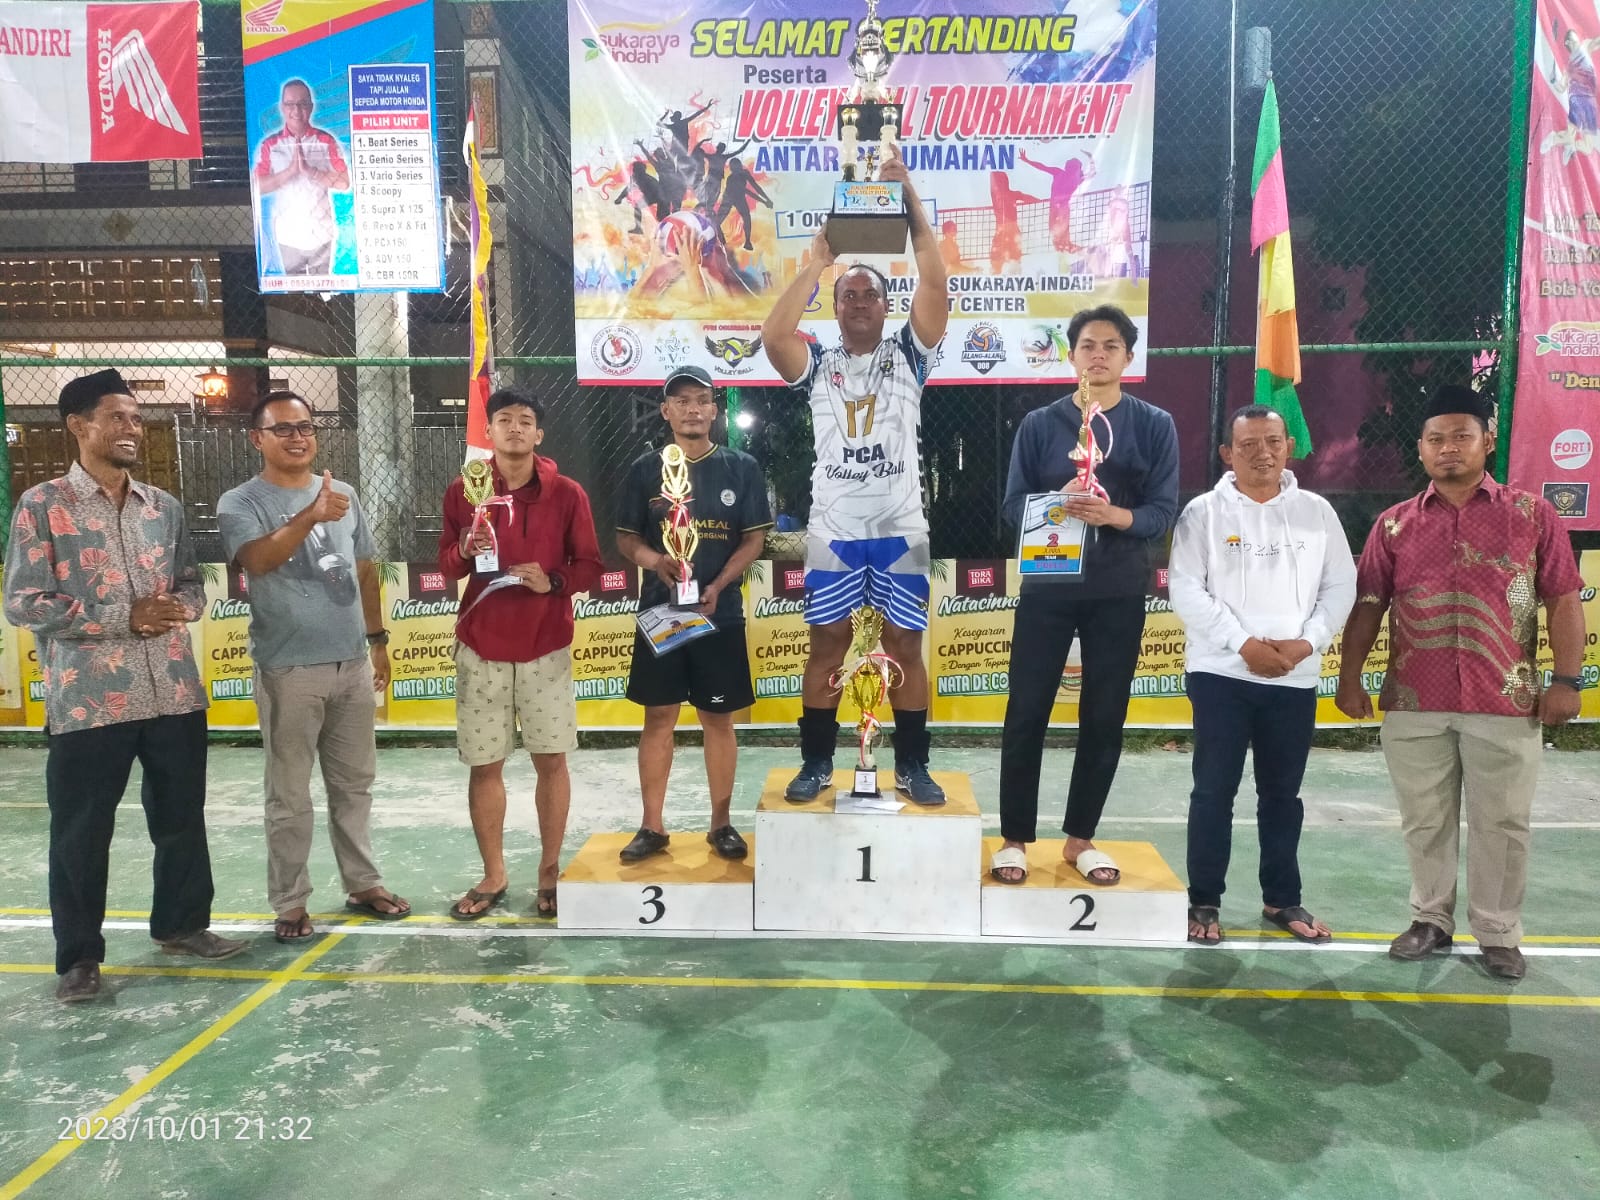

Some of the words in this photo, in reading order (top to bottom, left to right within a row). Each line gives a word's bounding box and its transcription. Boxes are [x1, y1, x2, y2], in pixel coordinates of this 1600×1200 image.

[246, 25, 287, 33] HONDA
[691, 18, 851, 57] SELAMAT
[860, 16, 1077, 53] ERTANDING
[97, 28, 115, 134] HONDA
[358, 74, 375, 83] SAYA
[376, 74, 393, 82] TIDAK
[395, 73, 420, 82] NYALEG
[743, 64, 827, 84] Peserta
[370, 85, 384, 94] TAPI
[385, 85, 409, 94] JUALAN
[354, 97, 379, 106] SEPEDA
[380, 97, 403, 106] MOTOR
[404, 96, 426, 106] HONDA
[922, 83, 1133, 137] TOURNAMENT
[362, 117, 390, 127] PILIH
[393, 117, 419, 126] UNIT
[368, 137, 388, 147] Beat
[390, 137, 418, 147] Series
[369, 154, 394, 164] Genio
[396, 154, 424, 164] Series
[755, 146, 840, 172] ANTAR
[370, 171, 393, 181] Vario
[395, 170, 423, 181] Series
[370, 186, 402, 198] Scoopy
[371, 204, 396, 216] Supra
[399, 204, 405, 213] X
[786, 213, 795, 228] 1
[802, 212, 830, 228] OK
[1541, 279, 1577, 297] Bola
[960, 297, 1026, 312] CENTER
[1551, 330, 1600, 343] sukara
[1562, 343, 1599, 356] indah
[845, 394, 876, 438] 17
[842, 443, 886, 464] PCA
[1554, 442, 1585, 453] FORT
[825, 464, 870, 482] Volley
[872, 460, 905, 479] Ball
[1046, 533, 1059, 547] 2
[970, 570, 991, 578] TORA
[971, 577, 992, 585] BIKA
[938, 593, 1020, 616] Natacinno
[954, 627, 1005, 640] Kesegaran
[402, 663, 435, 674] Dengan
[583, 663, 616, 674] Dengan
[766, 661, 798, 672] Dengan
[948, 660, 981, 671] Dengan
[212, 679, 241, 697] NATA
[393, 679, 425, 698] NATA
[427, 677, 445, 695] DE
[574, 679, 603, 697] NATA
[607, 677, 625, 695] DE
[756, 676, 788, 696] NATA
[938, 675, 970, 694] NATA
[972, 674, 989, 692] DE
[1161, 674, 1179, 693] DE
[856, 845, 876, 882] 1
[638, 885, 666, 925] 3
[1068, 893, 1098, 932] 2
